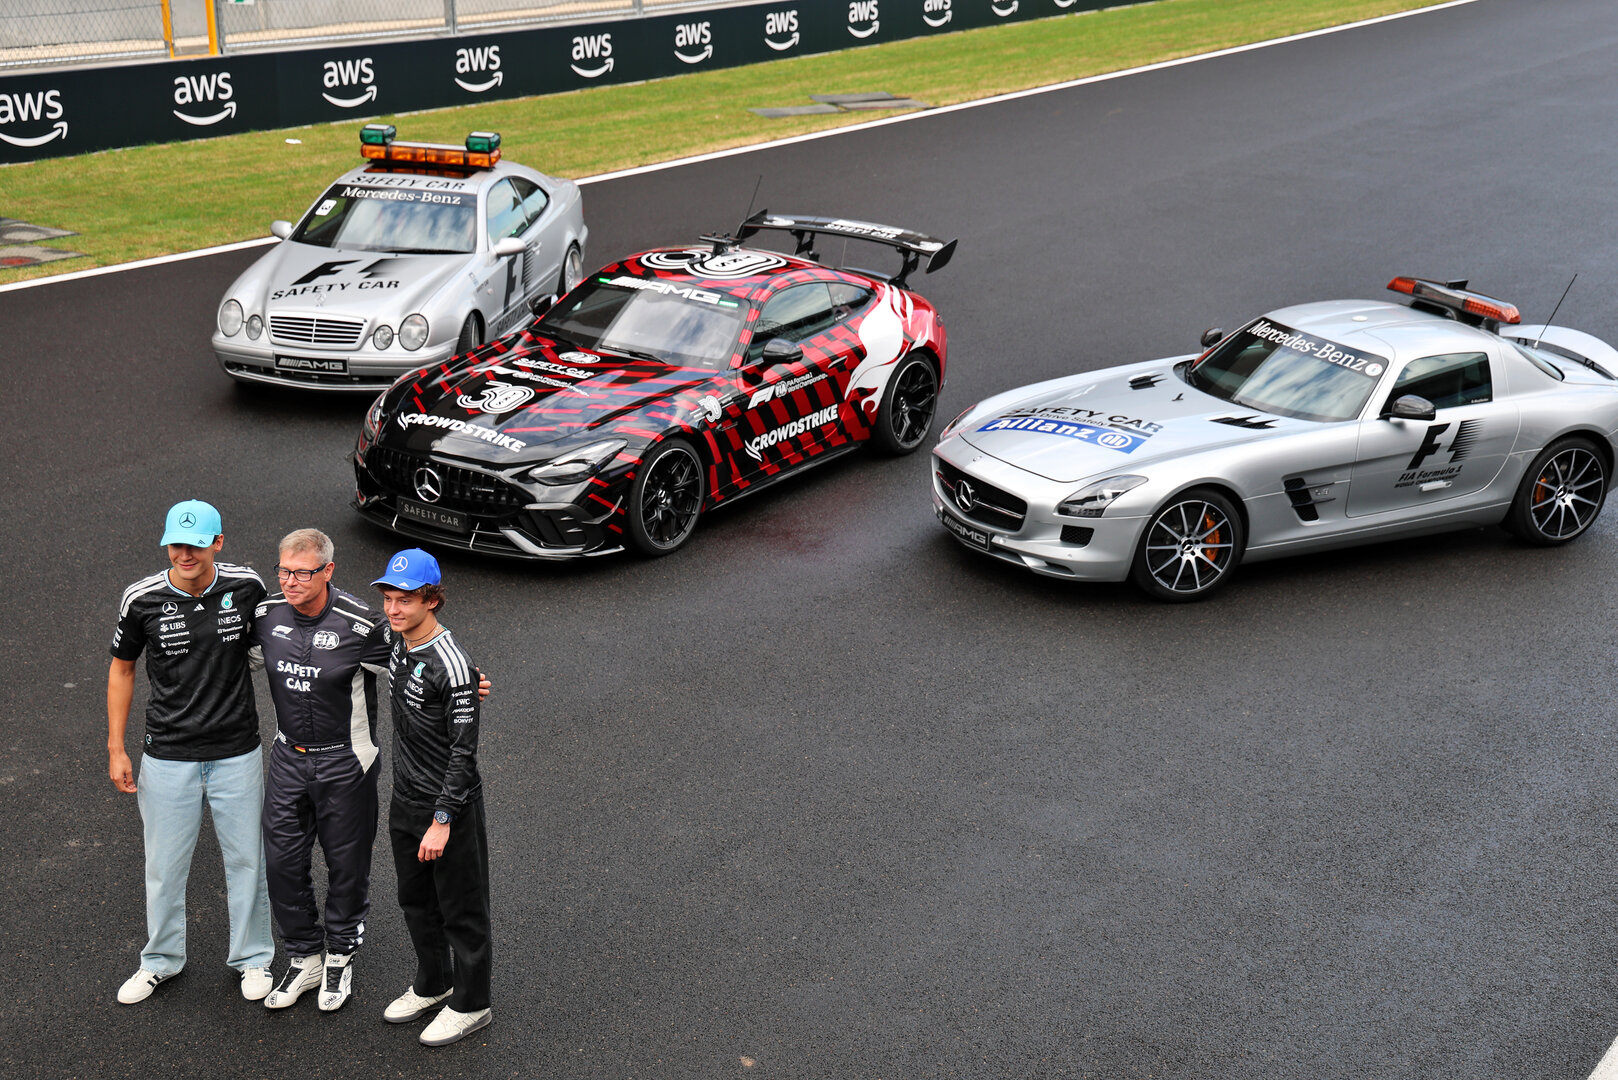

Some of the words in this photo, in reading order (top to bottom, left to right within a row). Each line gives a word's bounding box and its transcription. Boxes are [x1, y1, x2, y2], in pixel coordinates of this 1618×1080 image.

[766, 10, 798, 34] aws
[849, 0, 878, 23] aws
[676, 22, 711, 47] aws
[572, 33, 612, 60] aws
[456, 46, 500, 73] aws
[324, 58, 375, 87] aws
[174, 72, 232, 104] aws
[0, 90, 63, 124] aws
[351, 175, 422, 187] SAFETY
[425, 180, 465, 190] CAR
[341, 186, 461, 205] Mercedes-Benz
[271, 282, 352, 300] SAFETY
[358, 280, 400, 290] CAR
[639, 281, 722, 305] AMG
[1247, 320, 1368, 371] Mercedes-Benz
[298, 360, 344, 370] AMG
[518, 357, 568, 372] SAFETY
[565, 367, 595, 379] CAR
[457, 380, 535, 414] 30
[751, 403, 838, 452] CROWDSTRIKE
[986, 418, 1096, 439] Allianz
[1006, 406, 1104, 418] SAFETY
[1108, 415, 1164, 433] CAR
[1071, 416, 1108, 426] Safely
[405, 413, 527, 453] CROWDSTRIKE
[1406, 418, 1485, 470] F1
[1398, 471, 1416, 482] FIA
[1416, 465, 1456, 479] Formula
[1455, 464, 1464, 472] 1
[404, 503, 437, 520] SAFETY
[440, 514, 459, 527] CAR
[954, 523, 986, 545] AMG
[169, 621, 186, 630] UBS
[217, 615, 241, 625] INEOS
[314, 632, 338, 648] FIA
[277, 660, 322, 678] SAFETY
[286, 677, 311, 692] CAR
